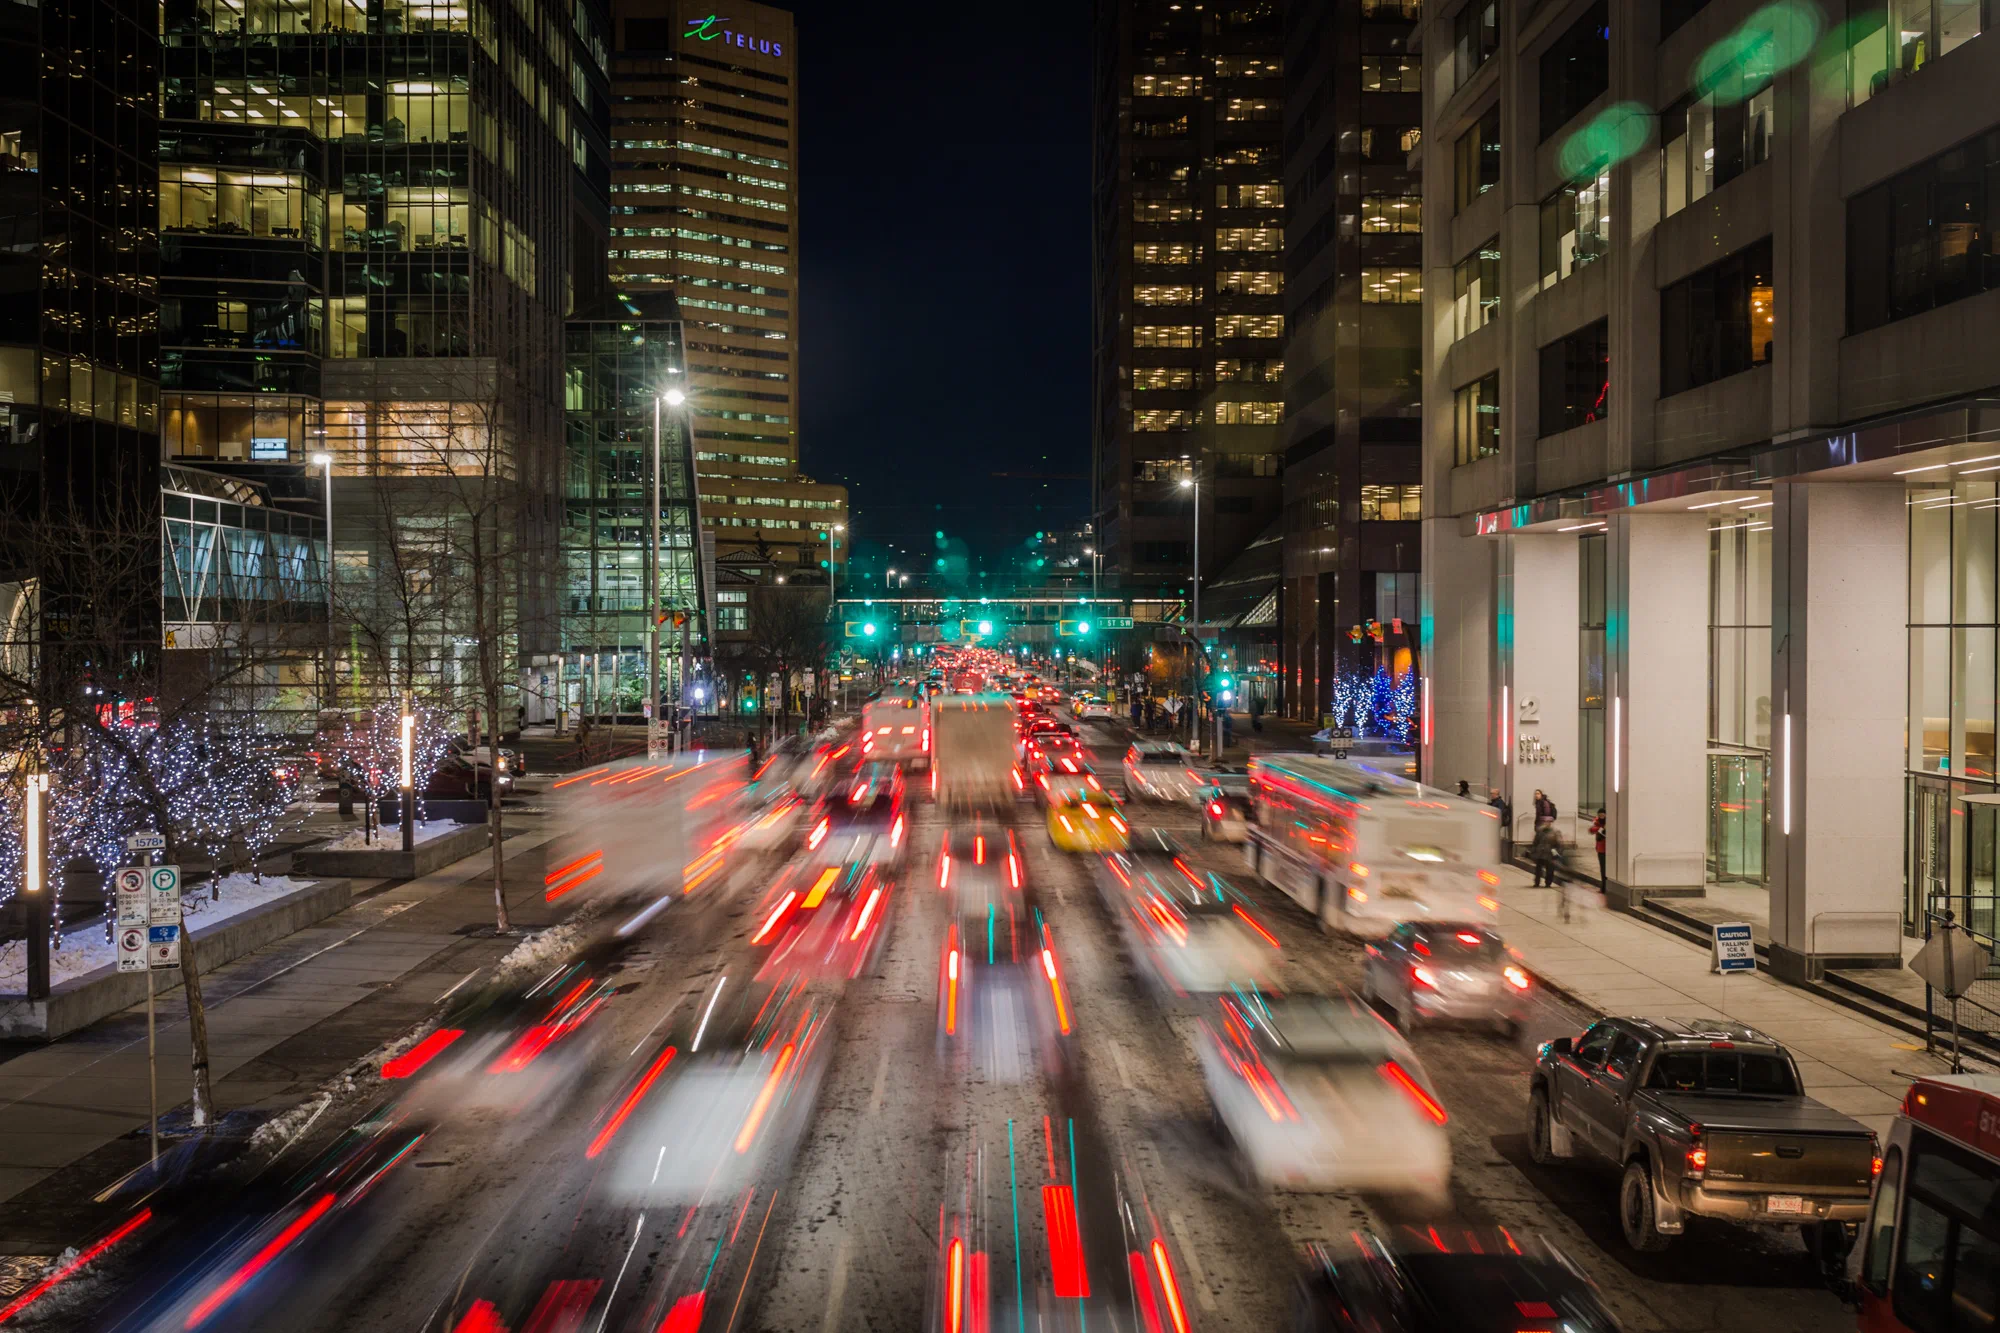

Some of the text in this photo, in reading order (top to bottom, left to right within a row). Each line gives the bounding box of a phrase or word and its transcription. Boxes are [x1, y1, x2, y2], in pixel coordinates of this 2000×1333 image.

[724, 29, 782, 57] TELUS
[1107, 619, 1116, 627] ST
[1120, 619, 1131, 627] SW
[1520, 695, 1540, 724] 2
[1520, 742, 1552, 752] Valley
[1520, 753, 1556, 762] Square
[135, 838, 159, 847] 1578
[159, 873, 171, 887] P
